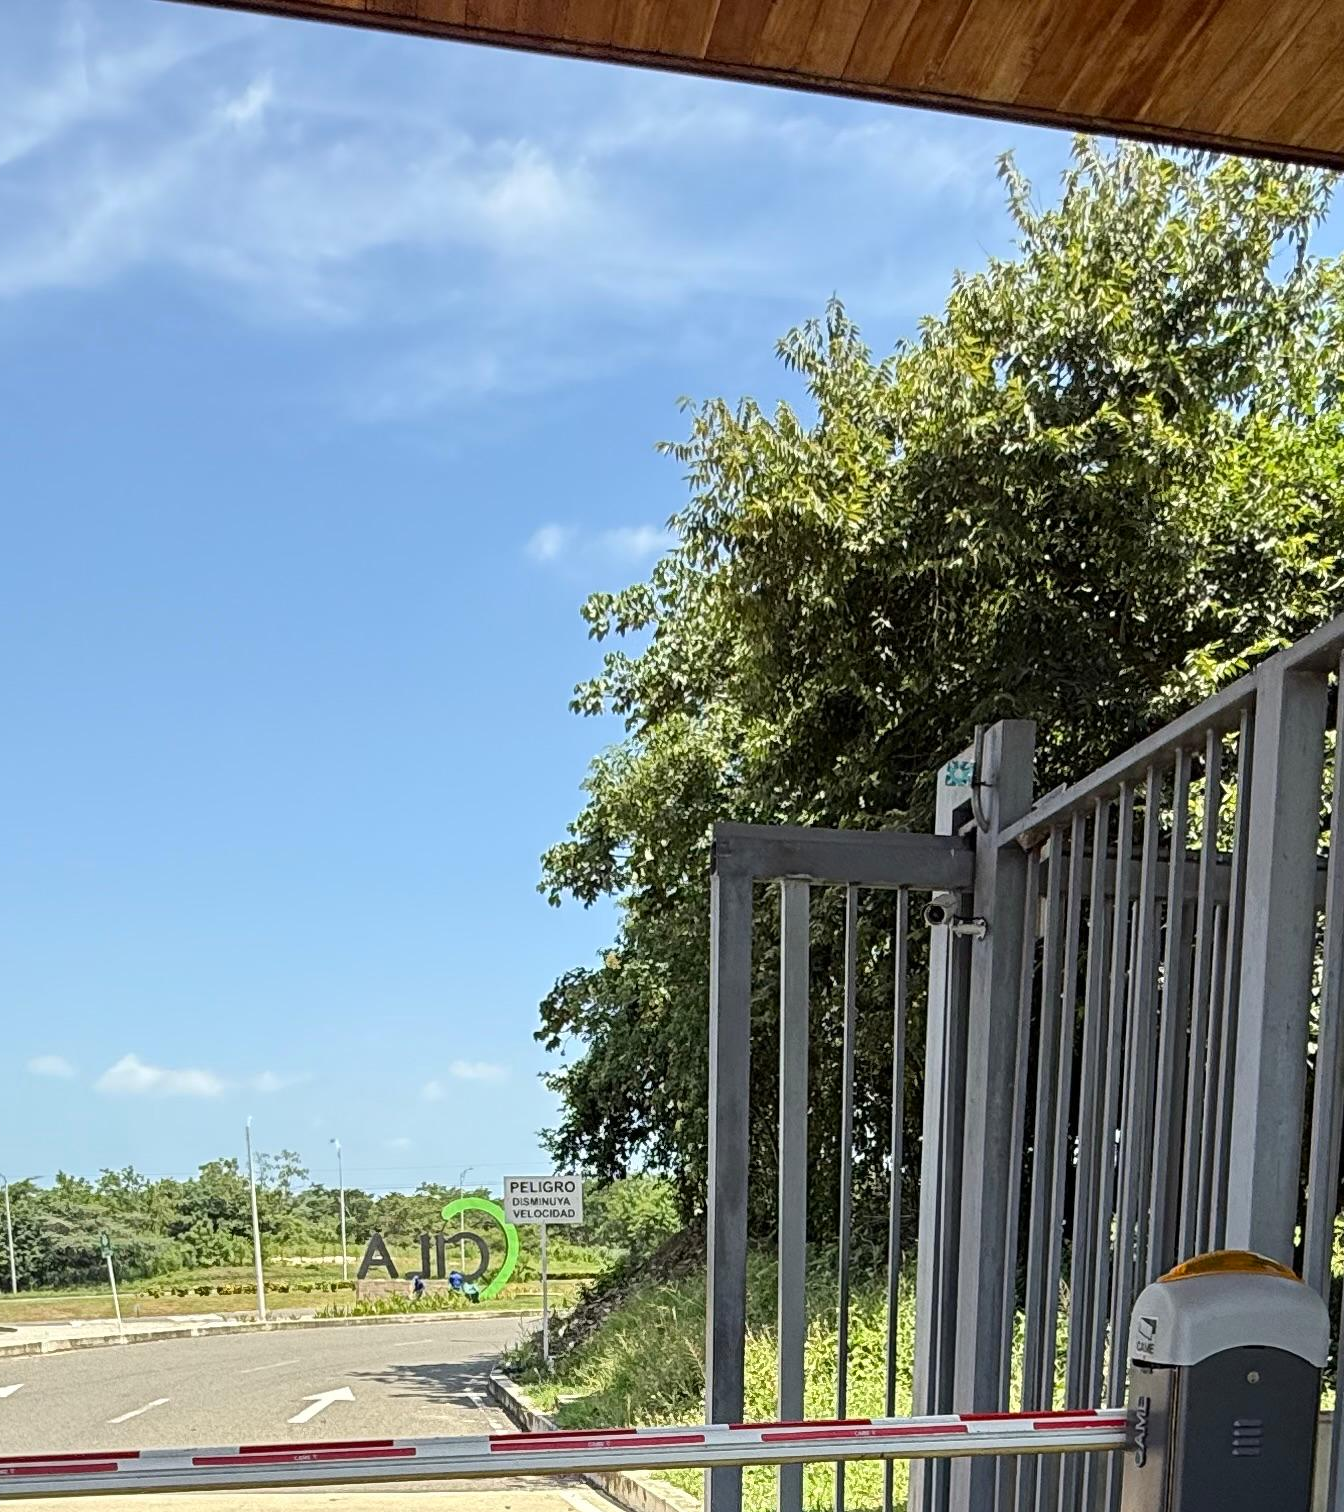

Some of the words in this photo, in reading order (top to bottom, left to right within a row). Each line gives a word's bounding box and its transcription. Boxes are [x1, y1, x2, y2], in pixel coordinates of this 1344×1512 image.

[510, 1181, 576, 1193] PELIGRO
[512, 1197, 571, 1206] DISMINUYA
[513, 1209, 575, 1218] VELOCIDAD
[1136, 1341, 1155, 1354] CAME
[1134, 1396, 1150, 1468] CAME
